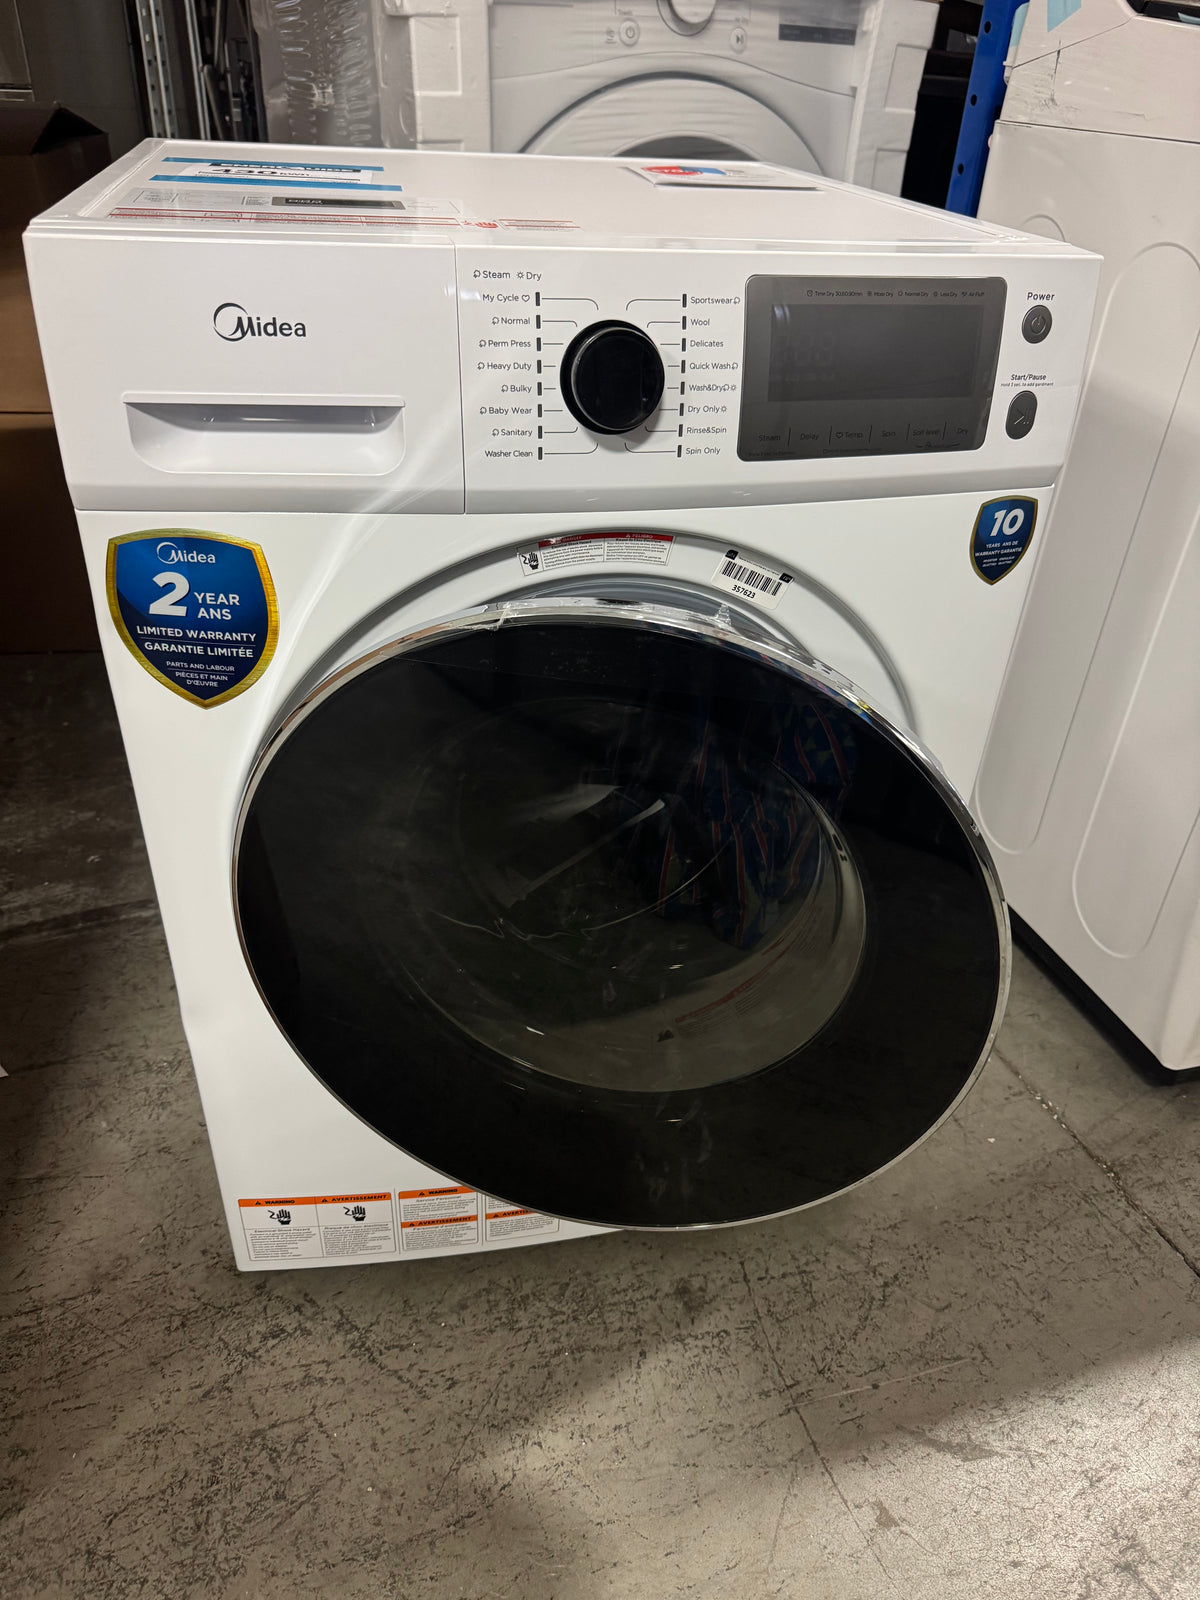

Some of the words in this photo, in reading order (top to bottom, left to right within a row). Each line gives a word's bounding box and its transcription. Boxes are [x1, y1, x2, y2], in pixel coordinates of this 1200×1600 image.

[482, 270, 510, 279] Steam
[526, 272, 541, 281] Dry
[482, 294, 494, 302] My
[497, 294, 519, 303] Cycle
[1027, 292, 1055, 300] Power
[216, 308, 306, 342] Midea
[487, 363, 512, 371] Heavy
[513, 363, 532, 371] Duty
[510, 385, 532, 393] Bulky
[689, 384, 724, 392] Wash&Dry
[488, 407, 509, 415] Baby
[703, 405, 720, 413] Only
[501, 429, 533, 437] Sanitary
[845, 431, 863, 439] Temp
[881, 430, 896, 438] Spin
[957, 428, 968, 436] Dry
[758, 433, 780, 442] Steam
[800, 433, 819, 441] Delay
[704, 447, 721, 455] Only
[990, 508, 1024, 536] 10
[158, 545, 216, 564] Midea
[149, 572, 190, 617] 2
[732, 584, 756, 599] 357623
[194, 592, 240, 606] YEAR
[198, 608, 232, 620] ANS
[136, 626, 183, 637] LIMITED
[186, 630, 256, 642] WARRANTY
[144, 642, 204, 655] GARANTIE
[207, 646, 253, 658] LIMITÉE
[186, 679, 218, 687] D'ŒUVRE
[418, 1217, 471, 1225] AVERTISSEMENT
